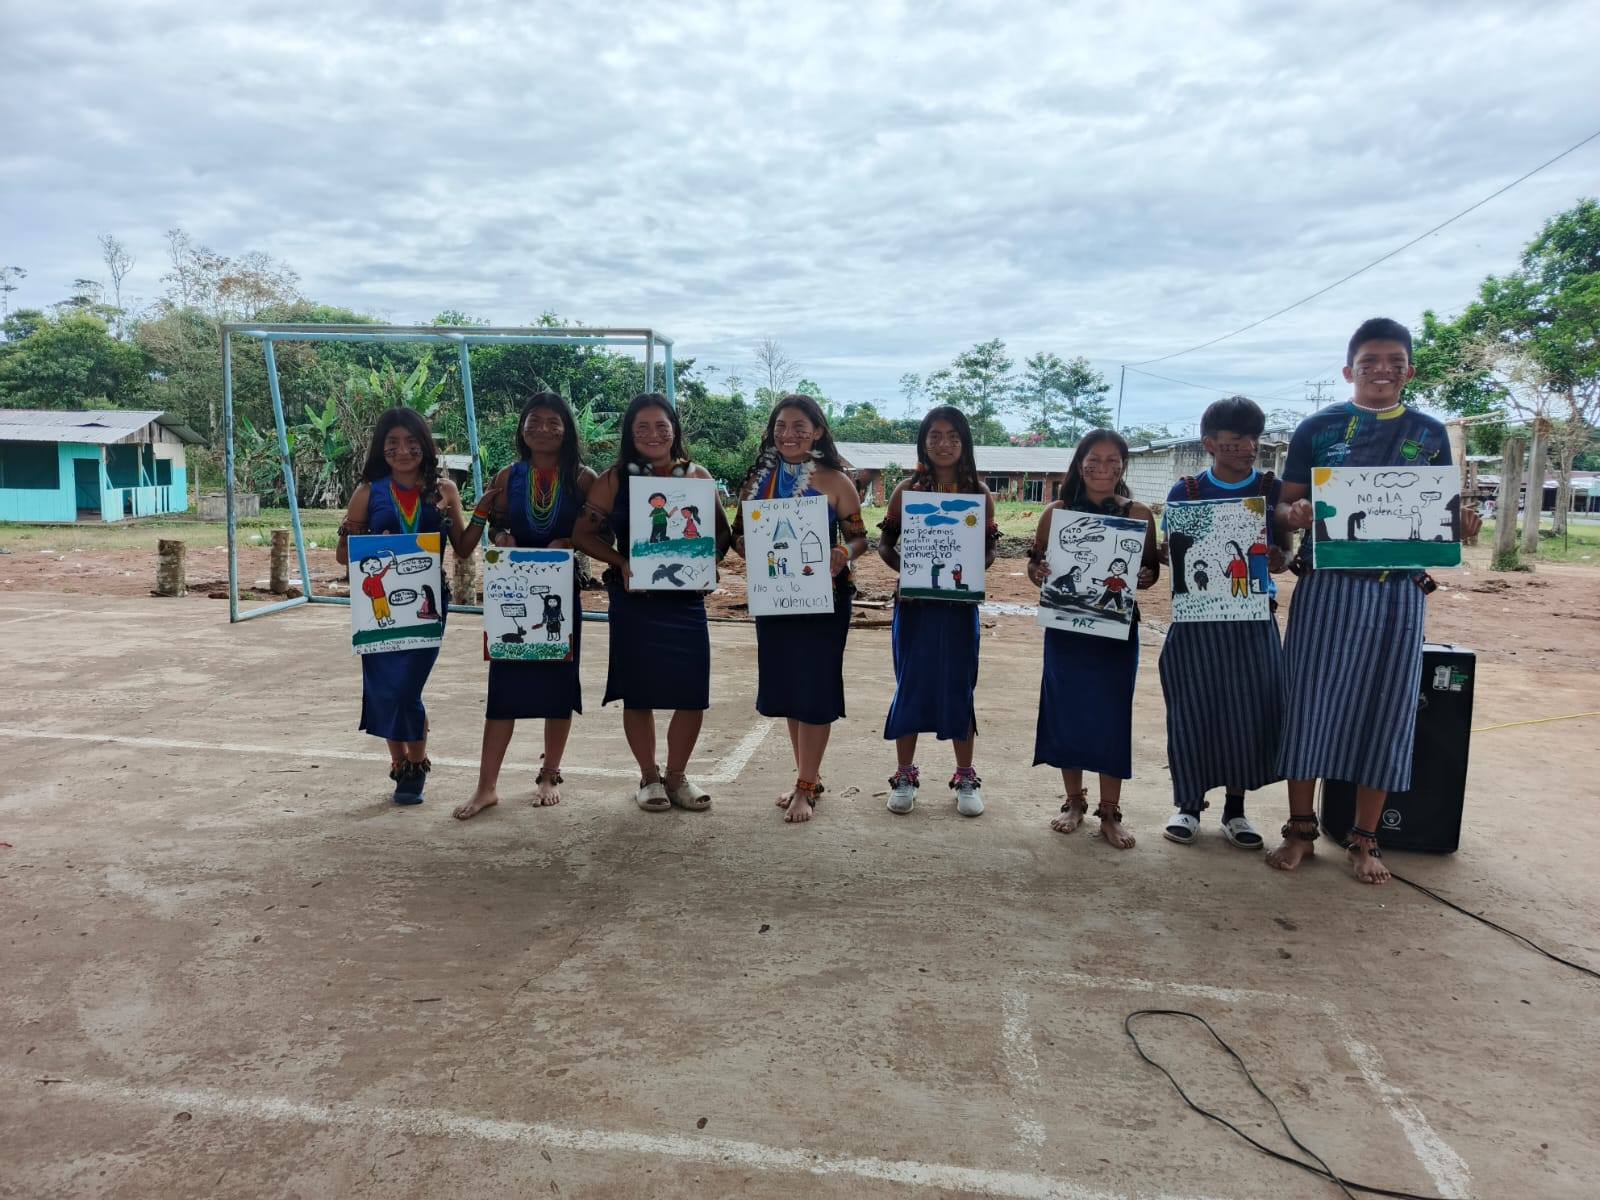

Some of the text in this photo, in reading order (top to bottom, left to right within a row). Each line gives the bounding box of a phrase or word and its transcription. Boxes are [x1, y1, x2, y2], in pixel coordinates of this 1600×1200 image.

[1357, 493, 1372, 504] NO
[1386, 491, 1402, 503] LA
[1071, 617, 1096, 630] PAZ
